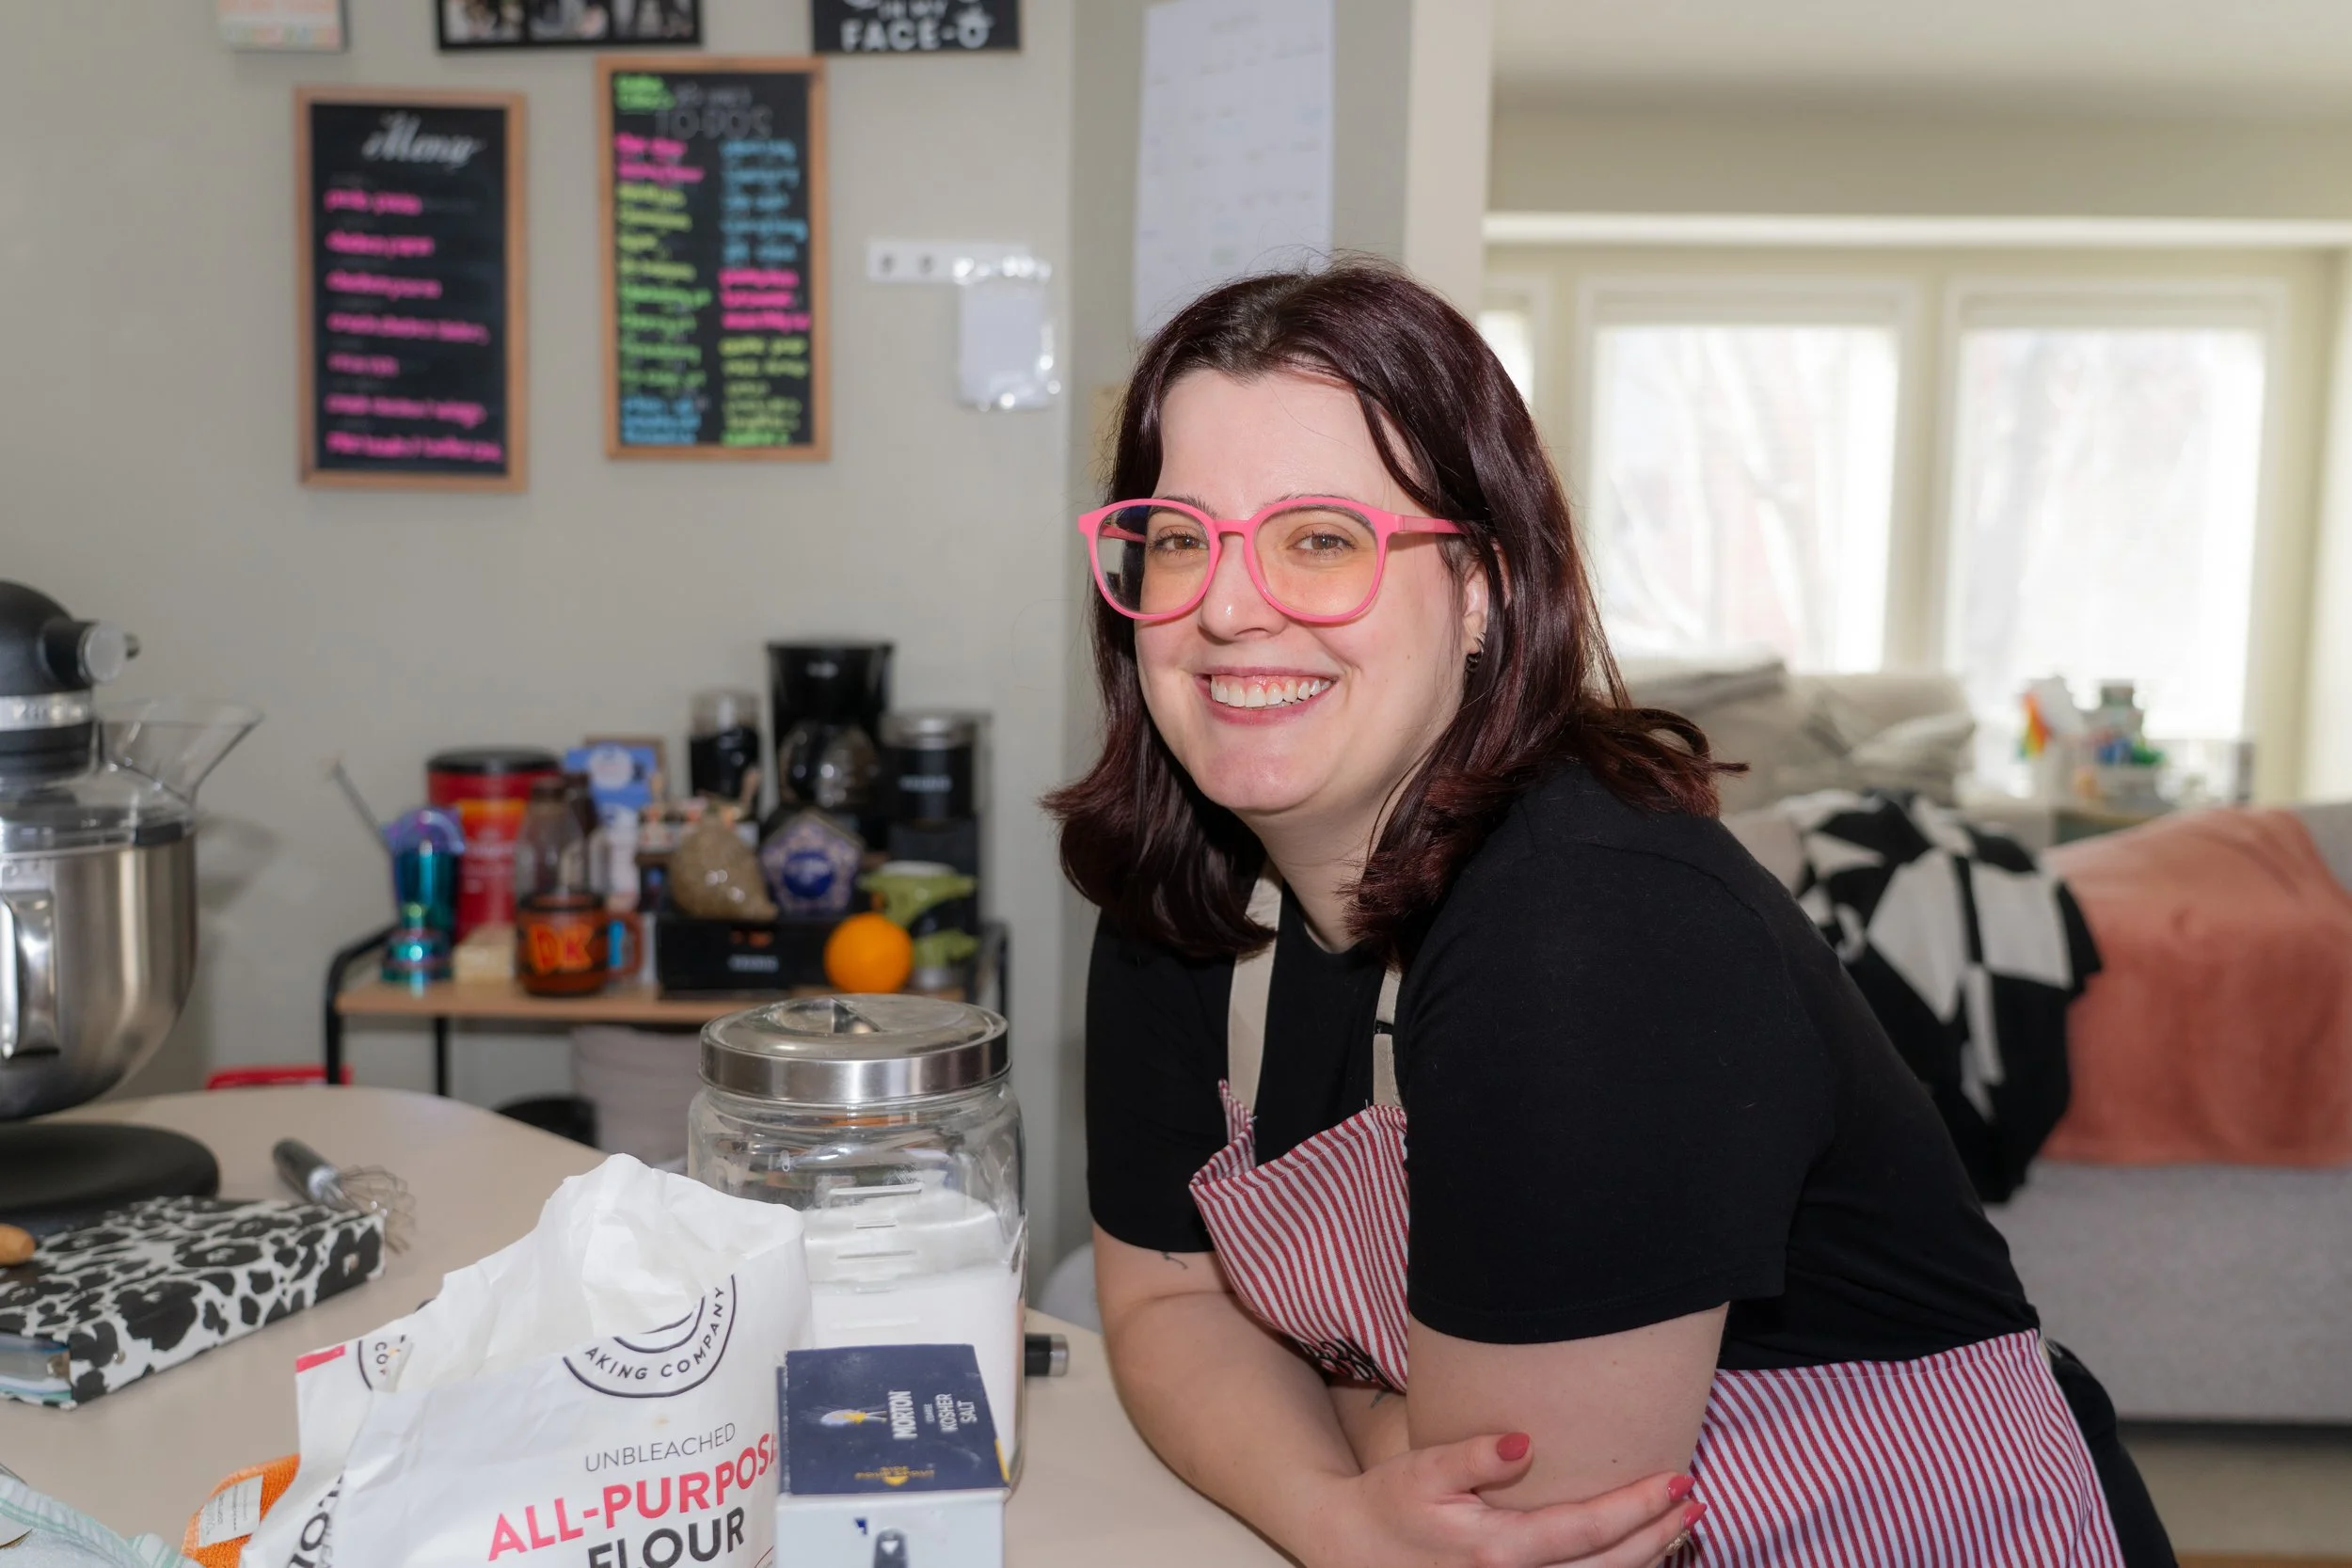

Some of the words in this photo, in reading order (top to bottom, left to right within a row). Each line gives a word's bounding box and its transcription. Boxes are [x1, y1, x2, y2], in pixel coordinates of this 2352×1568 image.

[529, 923, 593, 975] DK
[584, 1346, 649, 1380] AKING
[660, 1286, 725, 1378] COMPANY
[887, 1390, 918, 1440] MORTON
[934, 1392, 960, 1433] KOSHER
[957, 1400, 978, 1424] SALT
[585, 1421, 736, 1473] UNBLEACHED
